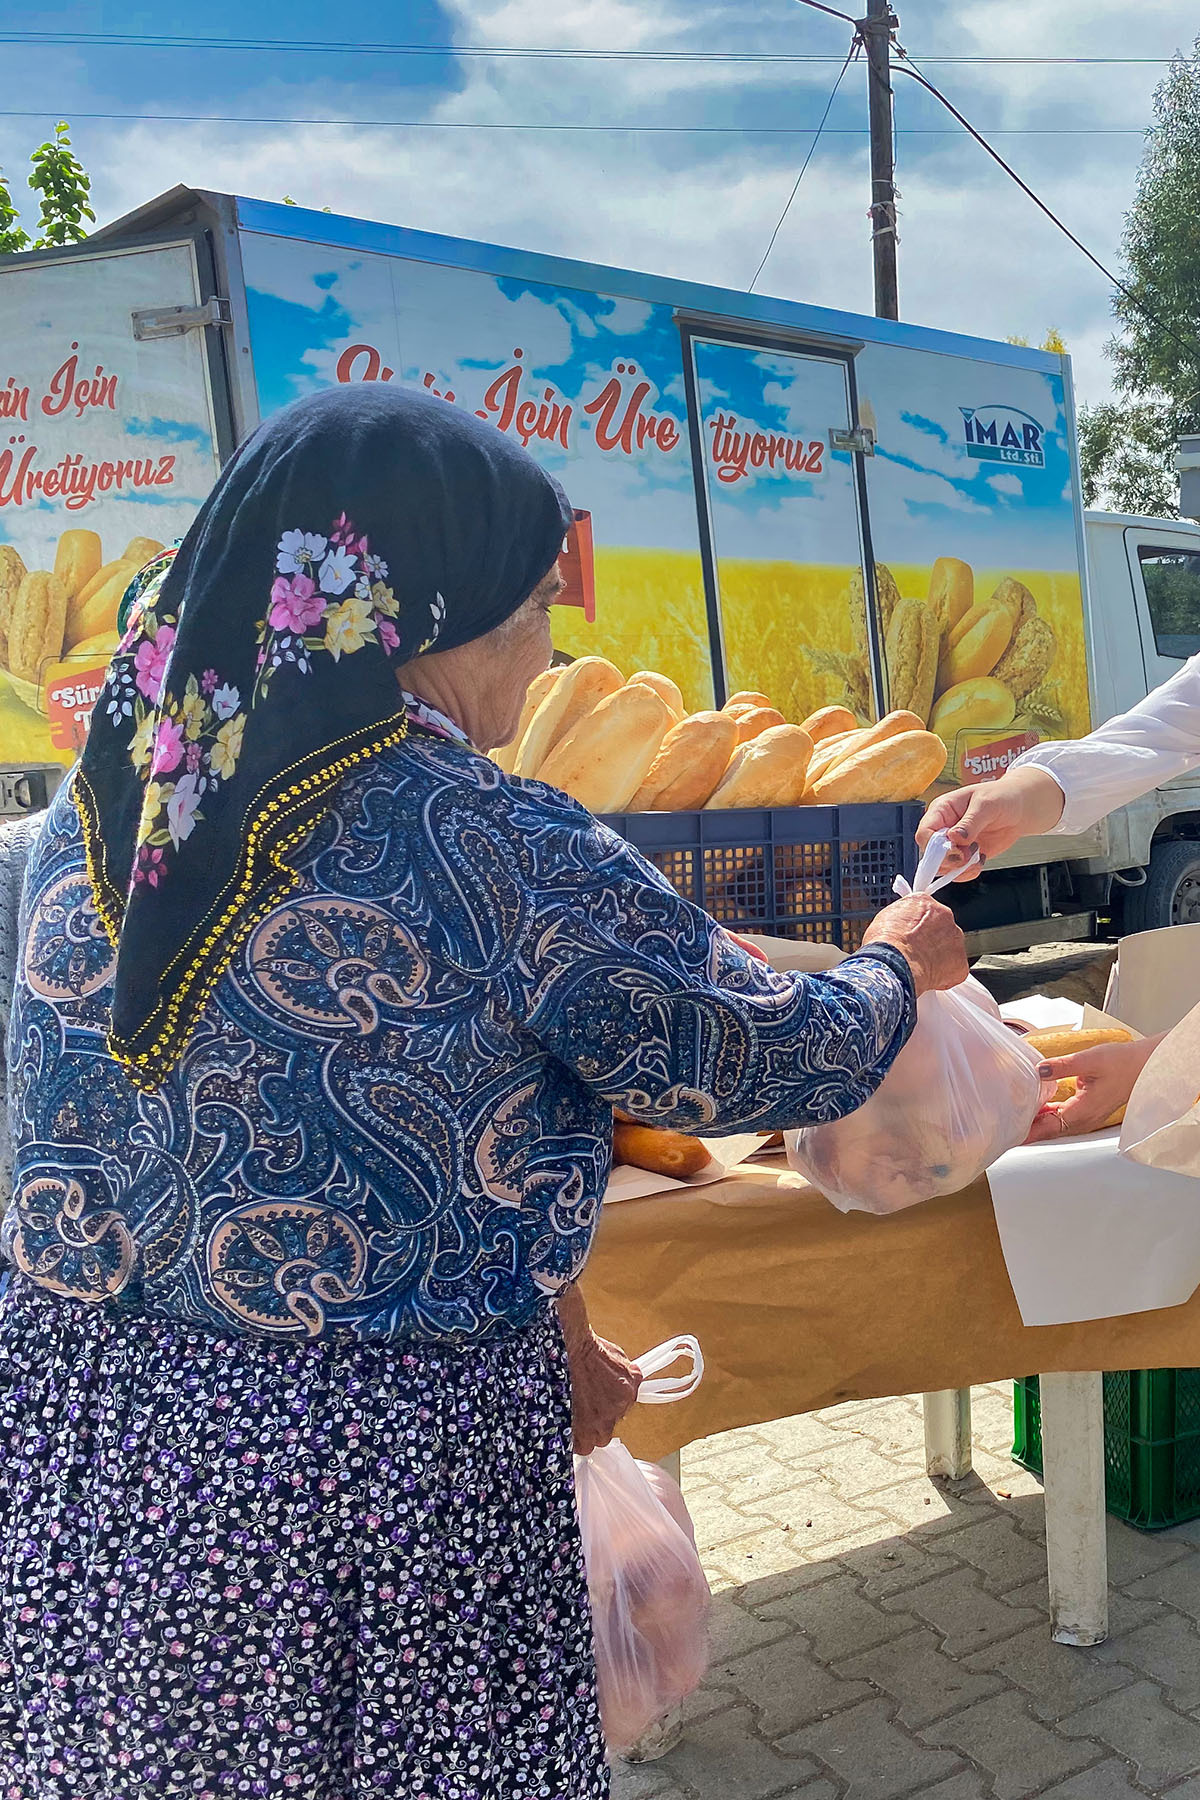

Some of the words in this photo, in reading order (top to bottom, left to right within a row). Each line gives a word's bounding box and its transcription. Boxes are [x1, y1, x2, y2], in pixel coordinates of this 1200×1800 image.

[41, 341, 118, 418] İçin
[474, 348, 573, 450] İçin
[0, 435, 176, 510] Üretiyoruz
[1000, 450, 1022, 462] Ltd.
